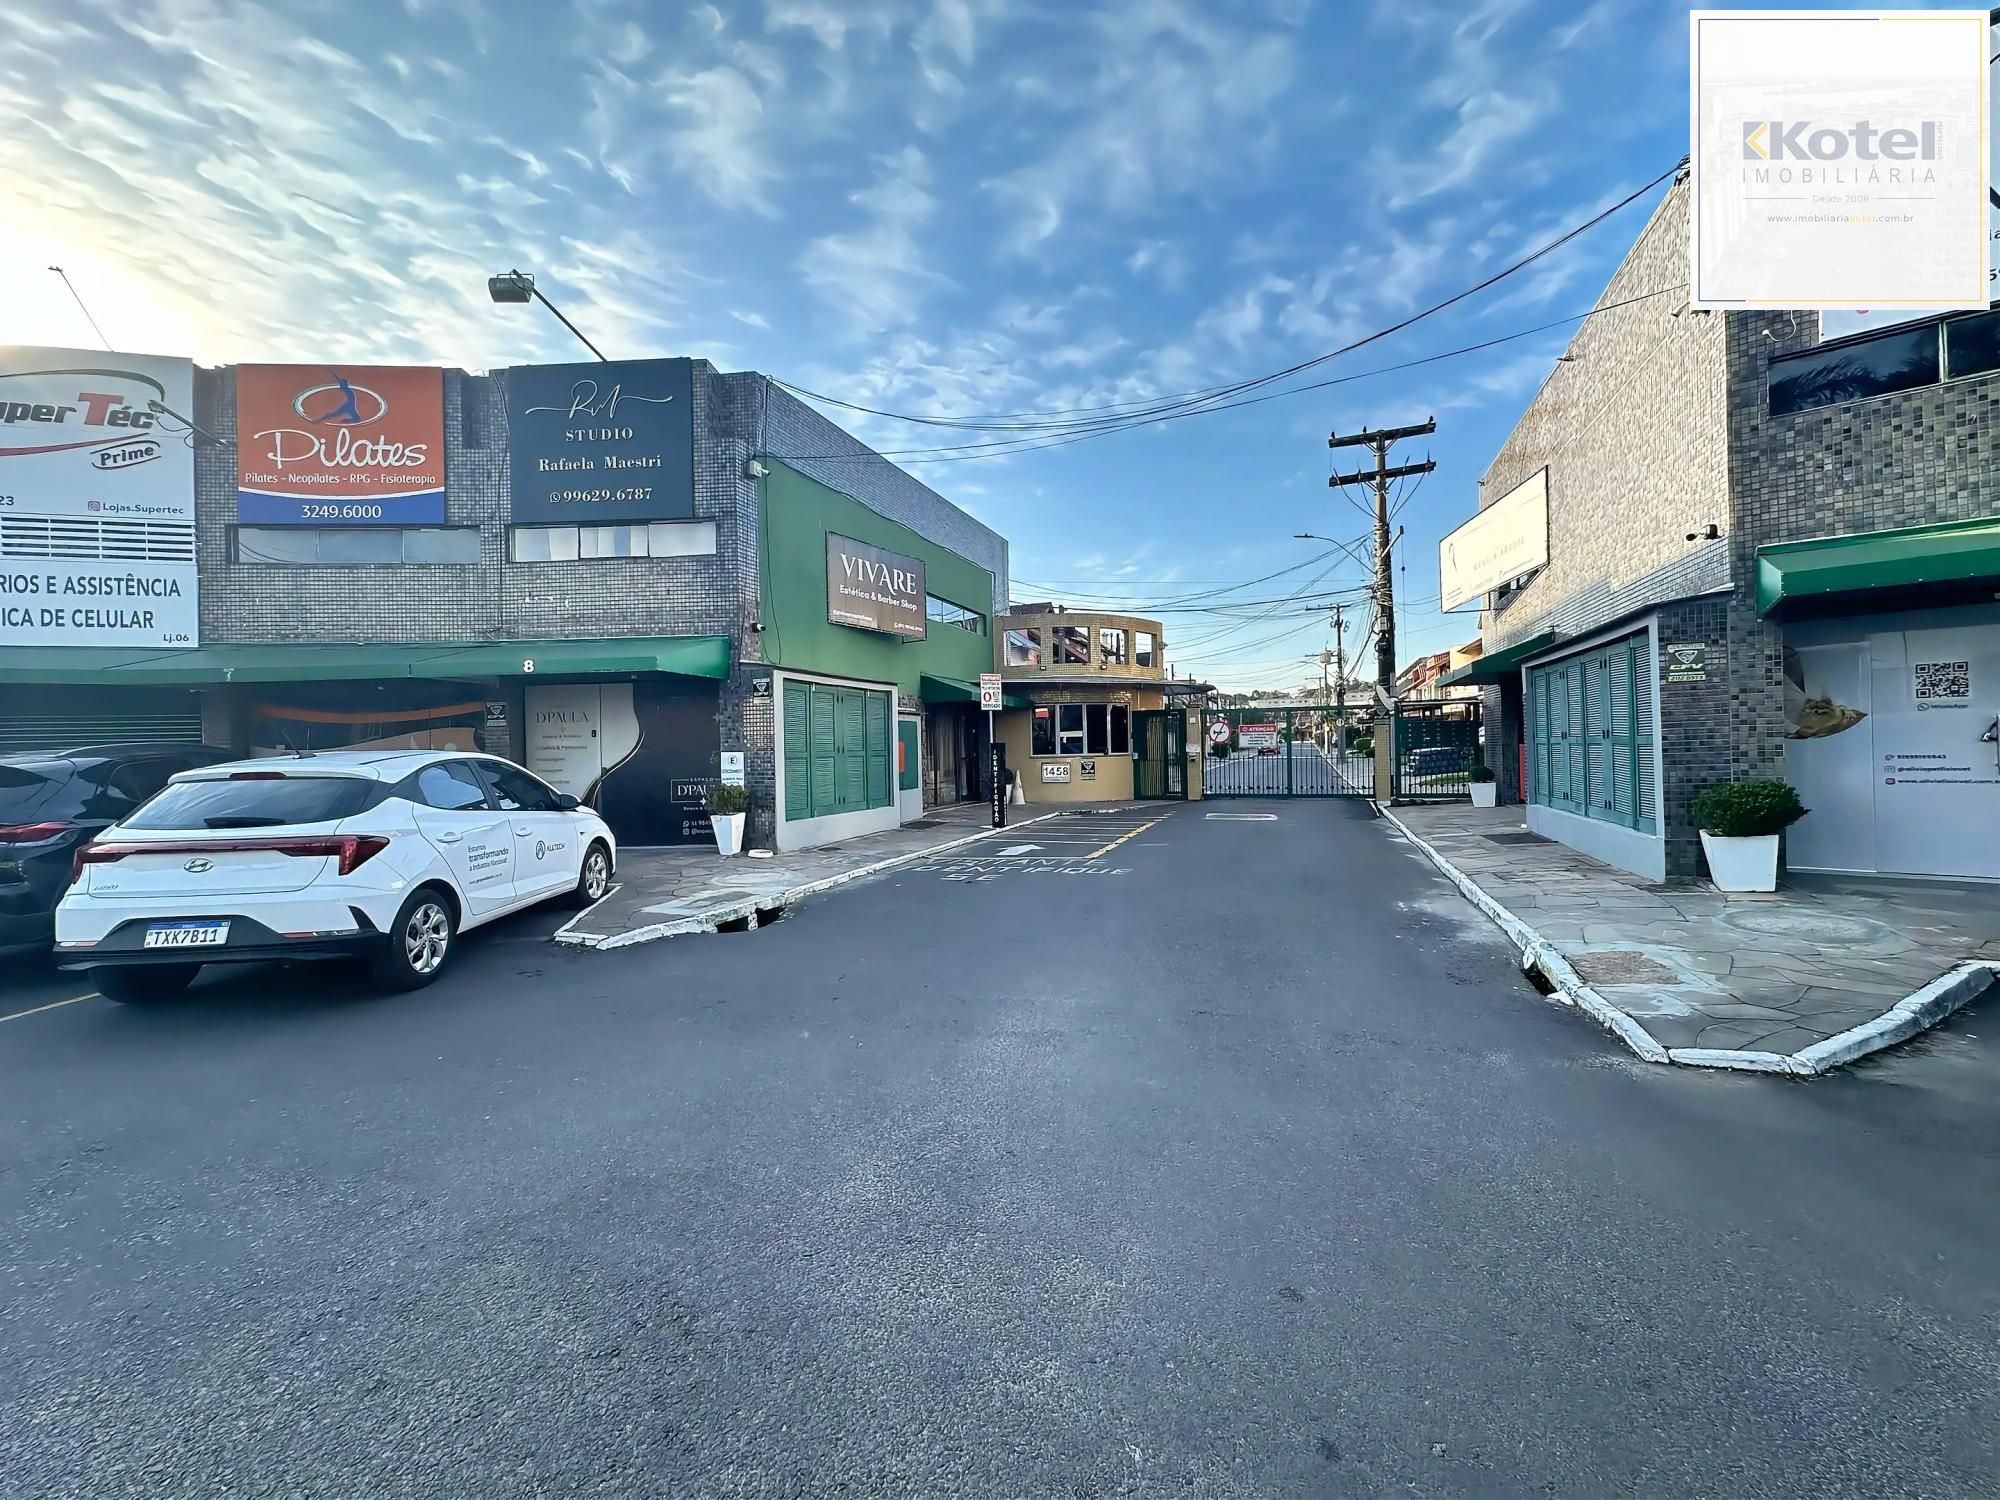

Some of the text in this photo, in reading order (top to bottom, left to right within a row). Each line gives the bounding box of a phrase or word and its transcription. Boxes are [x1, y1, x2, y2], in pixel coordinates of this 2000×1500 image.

[566, 427, 633, 442] STUDIO
[100, 445, 154, 466] Prime
[253, 428, 427, 469] Pilates
[539, 455, 662, 472] Rafaela Maestri
[245, 473, 435, 485] Pilates Neopilates RPG Fisioterapia
[563, 488, 652, 503] 99629.6787
[103, 502, 184, 515] Lojas.Supertec
[301, 505, 382, 518] 3249.6000
[840, 553, 917, 596] VIVARE
[46, 575, 57, 594] E
[63, 573, 181, 597] ASSISTÊNCIA
[839, 584, 918, 613] Estética & Barber Shop
[40, 608, 66, 628] DE
[71, 609, 154, 629] CELULAR
[163, 633, 189, 643] Lj.06
[523, 660, 535, 673] 8
[1044, 767, 1069, 776] 1458
[469, 848, 509, 862] transformando
[154, 928, 218, 946] TXK7B11
